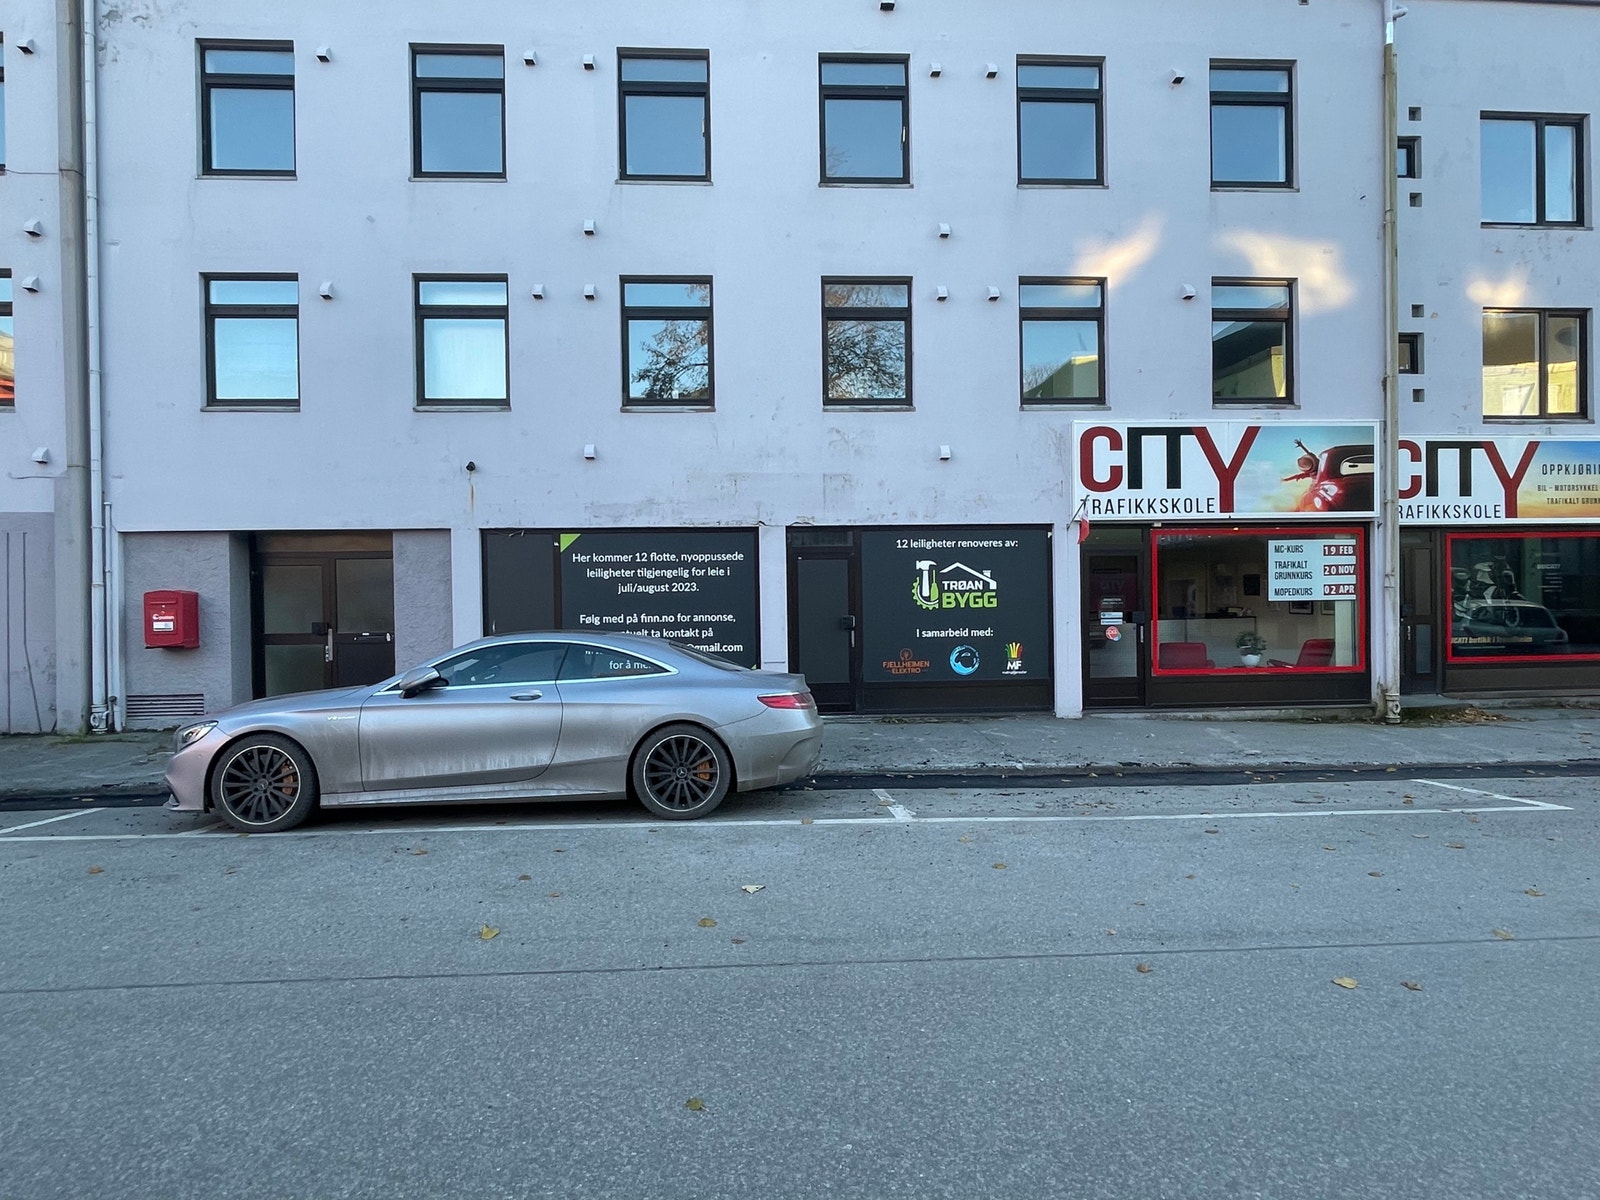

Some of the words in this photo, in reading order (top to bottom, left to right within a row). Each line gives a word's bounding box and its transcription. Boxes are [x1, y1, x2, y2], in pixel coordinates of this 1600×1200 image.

[1079, 426, 1262, 513] CITY
[1398, 504, 1502, 519] RAFIKKSKOLE
[896, 540, 909, 549] 12
[910, 539, 956, 550] leiligheter
[957, 540, 1003, 548] renoveres
[1274, 545, 1304, 554] MC-KURS
[1339, 546, 1354, 555] FEB
[572, 553, 592, 563] Her
[592, 552, 633, 562] kommer
[635, 552, 648, 562] 12
[650, 552, 679, 563] flotte,
[681, 551, 744, 564] nyoppussede
[1274, 560, 1308, 569] TRAFIKALT
[1338, 565, 1355, 574] NOV
[586, 568, 636, 580] leiligheter
[637, 567, 690, 579] tilgjengelig
[691, 567, 706, 576] for
[707, 567, 725, 576] leie
[1274, 571, 1313, 580] GRUNNKURS
[617, 583, 670, 594] juli/august
[671, 582, 700, 592] 2023.
[942, 581, 983, 590] TRØAN
[1274, 588, 1313, 596] MOPEDKURS
[1339, 585, 1355, 594] APR
[942, 592, 998, 608] BYGG
[579, 614, 601, 625] Følg
[602, 614, 624, 624] med
[626, 613, 638, 625] på
[640, 613, 675, 623] finn.no
[677, 613, 691, 622] for
[692, 613, 736, 624] annonse,
[651, 629, 661, 638] ta
[662, 628, 700, 638] kontakt
[701, 627, 714, 639] på
[921, 628, 969, 638] samarbeid
[971, 627, 994, 637] med:
[609, 660, 624, 670] for
[1007, 661, 1021, 670] MF
